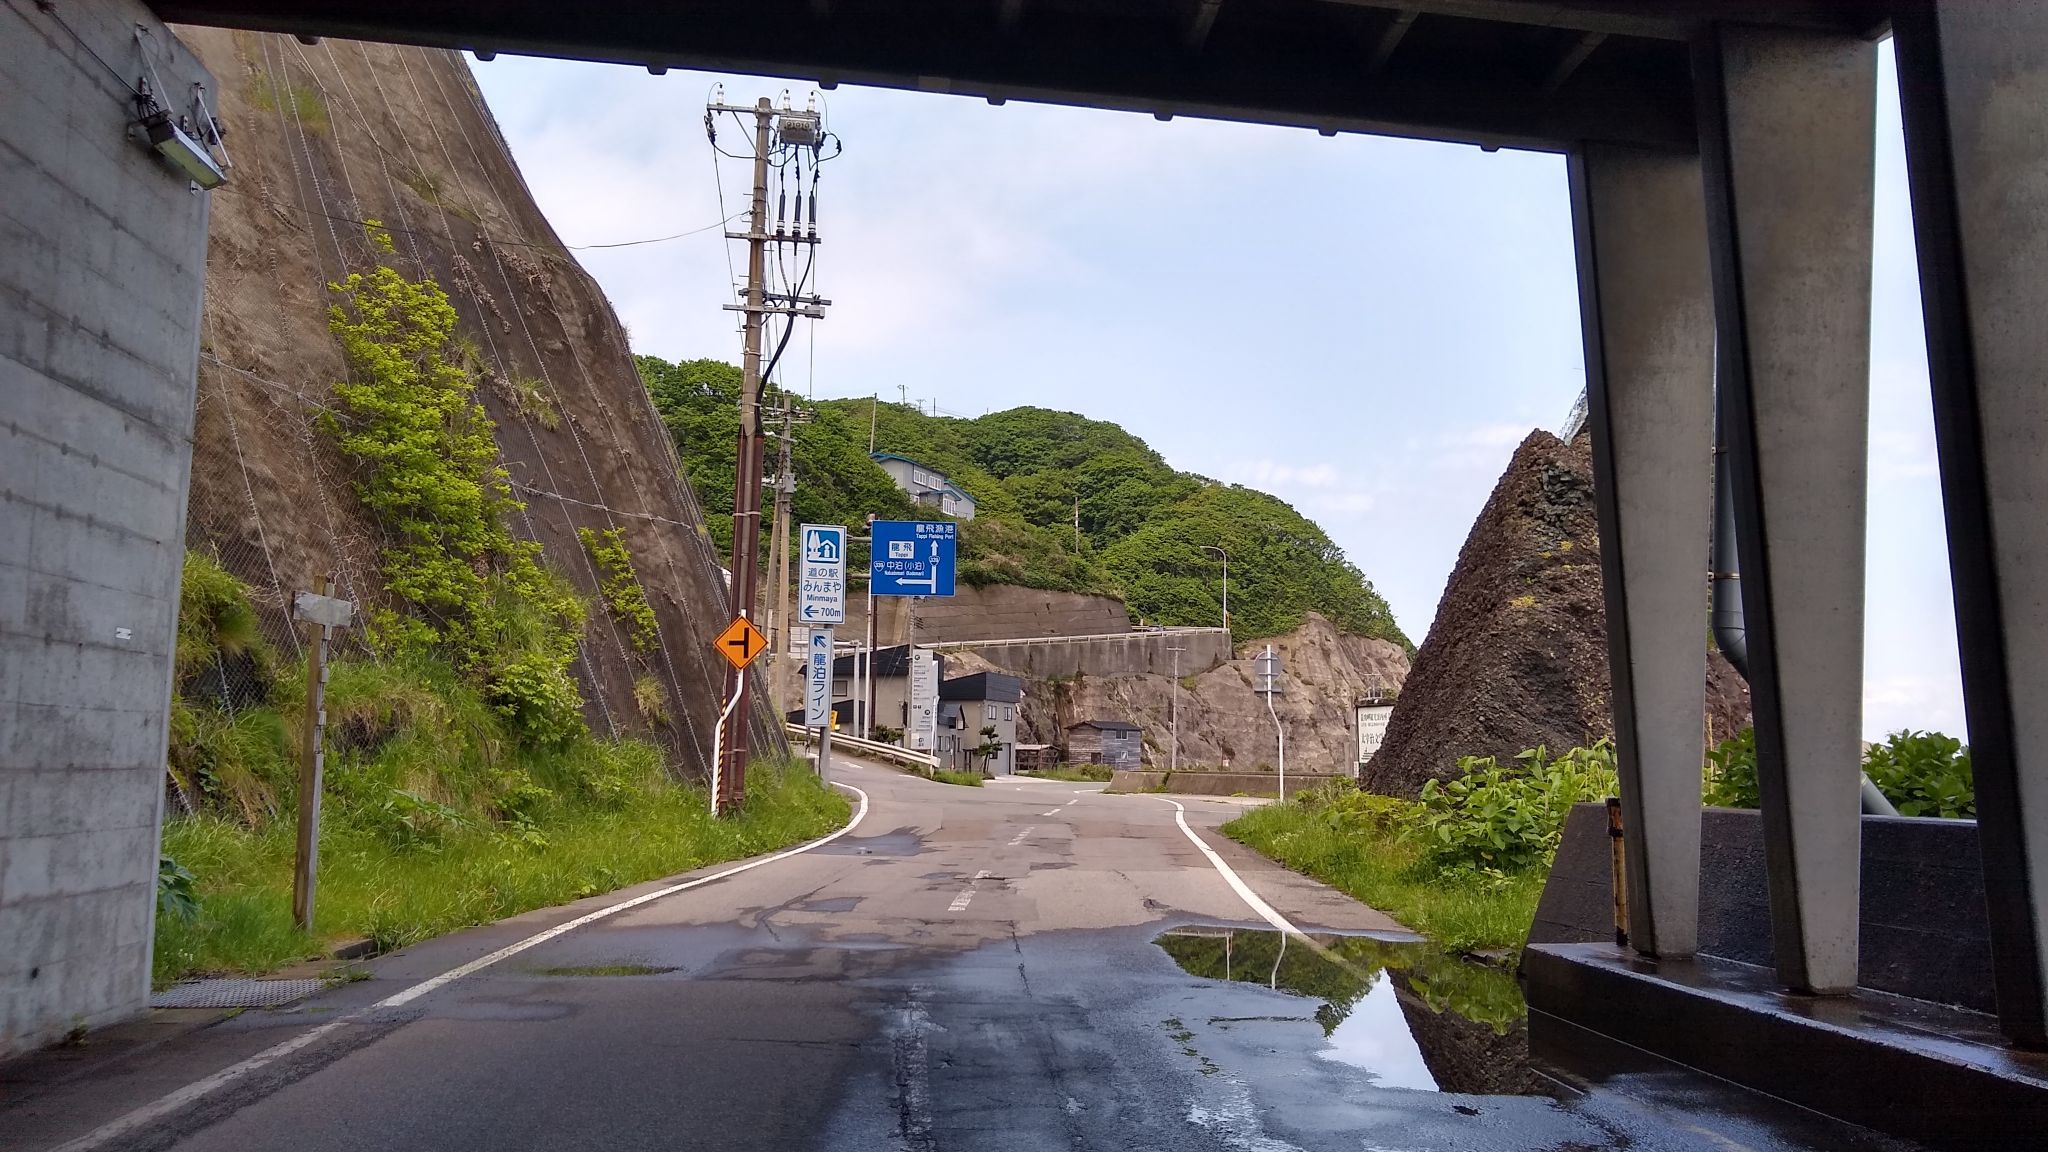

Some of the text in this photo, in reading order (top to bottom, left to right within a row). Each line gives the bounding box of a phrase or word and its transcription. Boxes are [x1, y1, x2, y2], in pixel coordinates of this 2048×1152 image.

[807, 567, 839, 578] 道の駅
[803, 580, 842, 593] みんまや
[806, 594, 838, 603] Minmaya
[820, 607, 841, 617] 700m
[812, 653, 826, 720] 龍泊ライン
